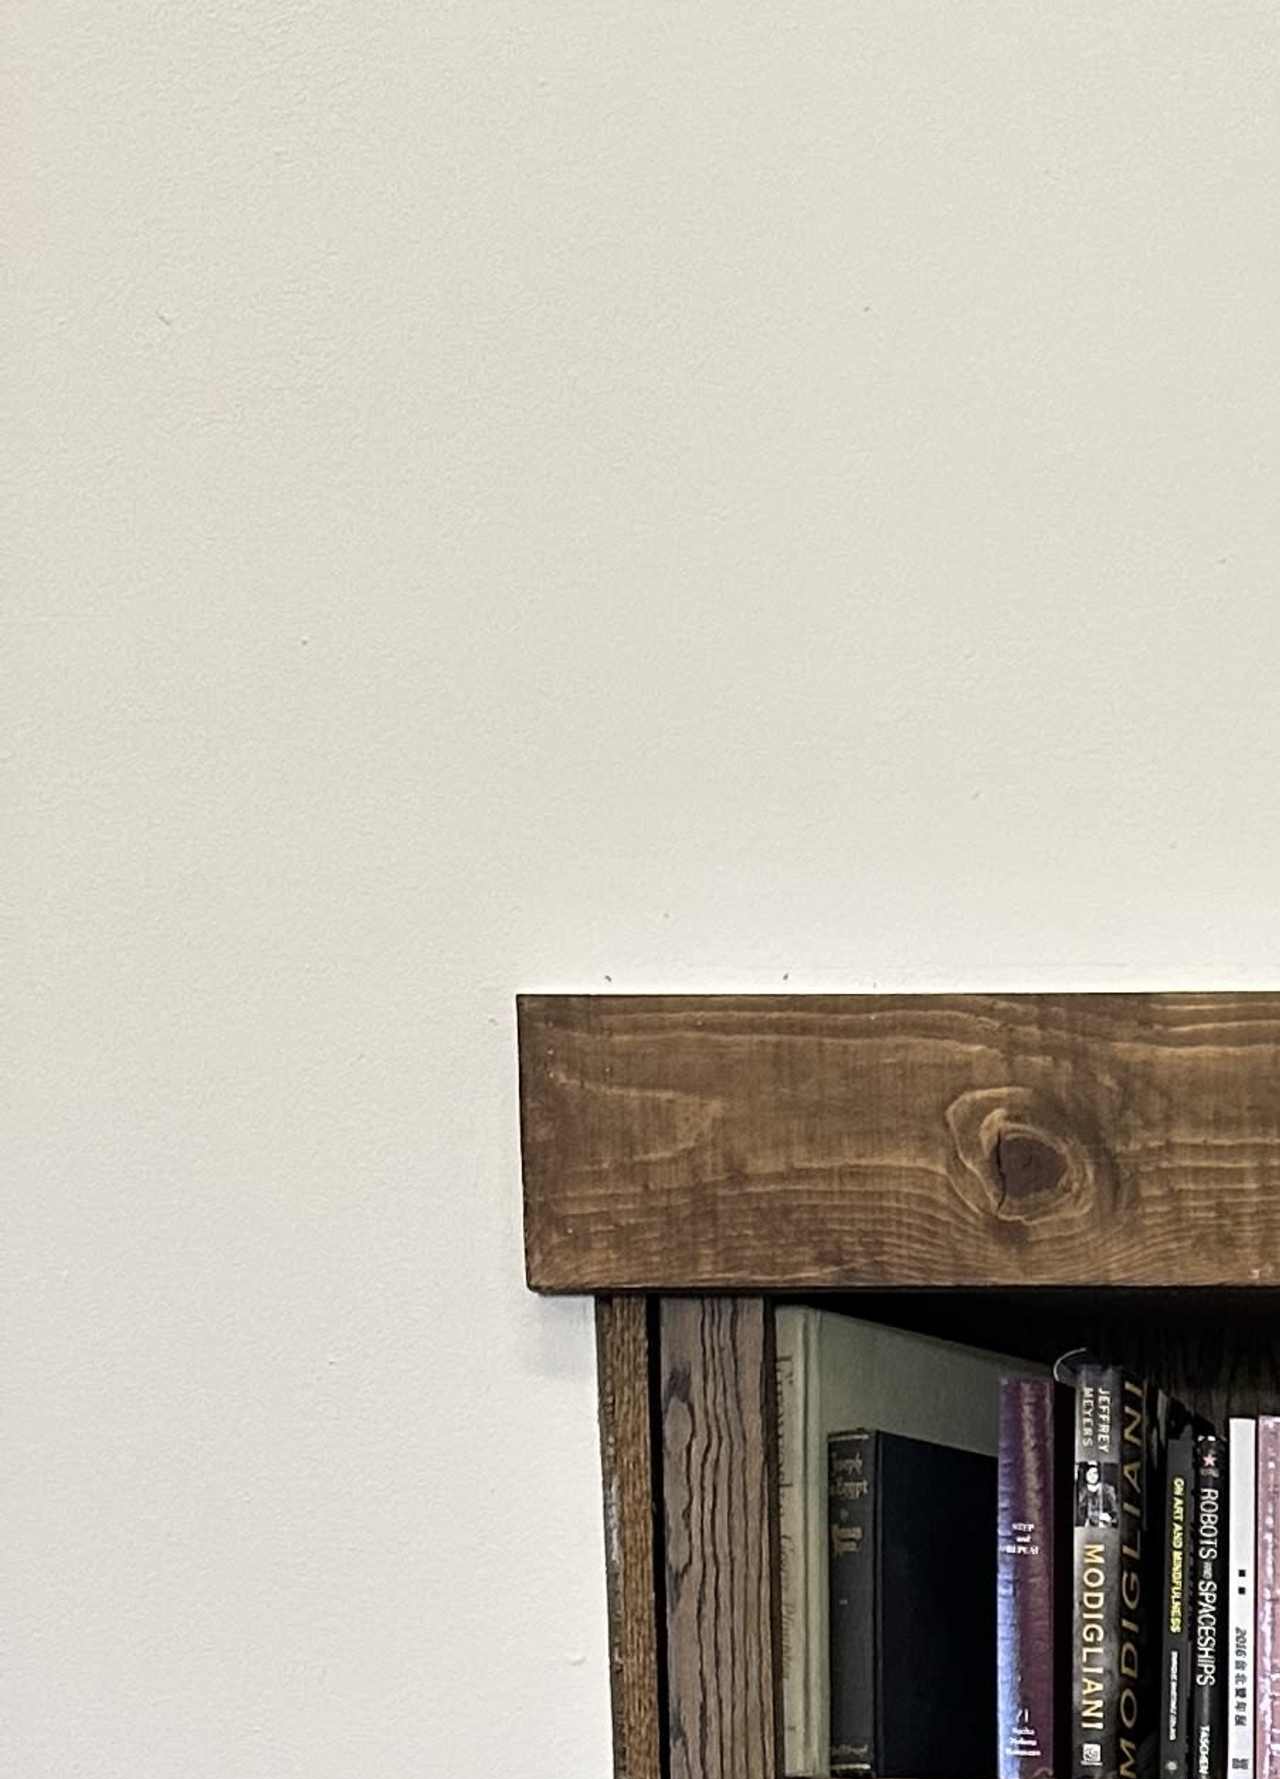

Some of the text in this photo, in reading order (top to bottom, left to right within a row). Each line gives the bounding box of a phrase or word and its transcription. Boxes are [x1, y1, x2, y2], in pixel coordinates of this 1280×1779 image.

[1081, 1387, 1095, 1448] MEYERS
[1097, 1387, 1111, 1454] JEFFREY
[1172, 1497, 1184, 1522] ART
[1172, 1522, 1184, 1549] AND
[1196, 1488, 1219, 1686] ROBOTS SPACESHIPS
[1081, 1543, 1105, 1731] MODIGLIANI
